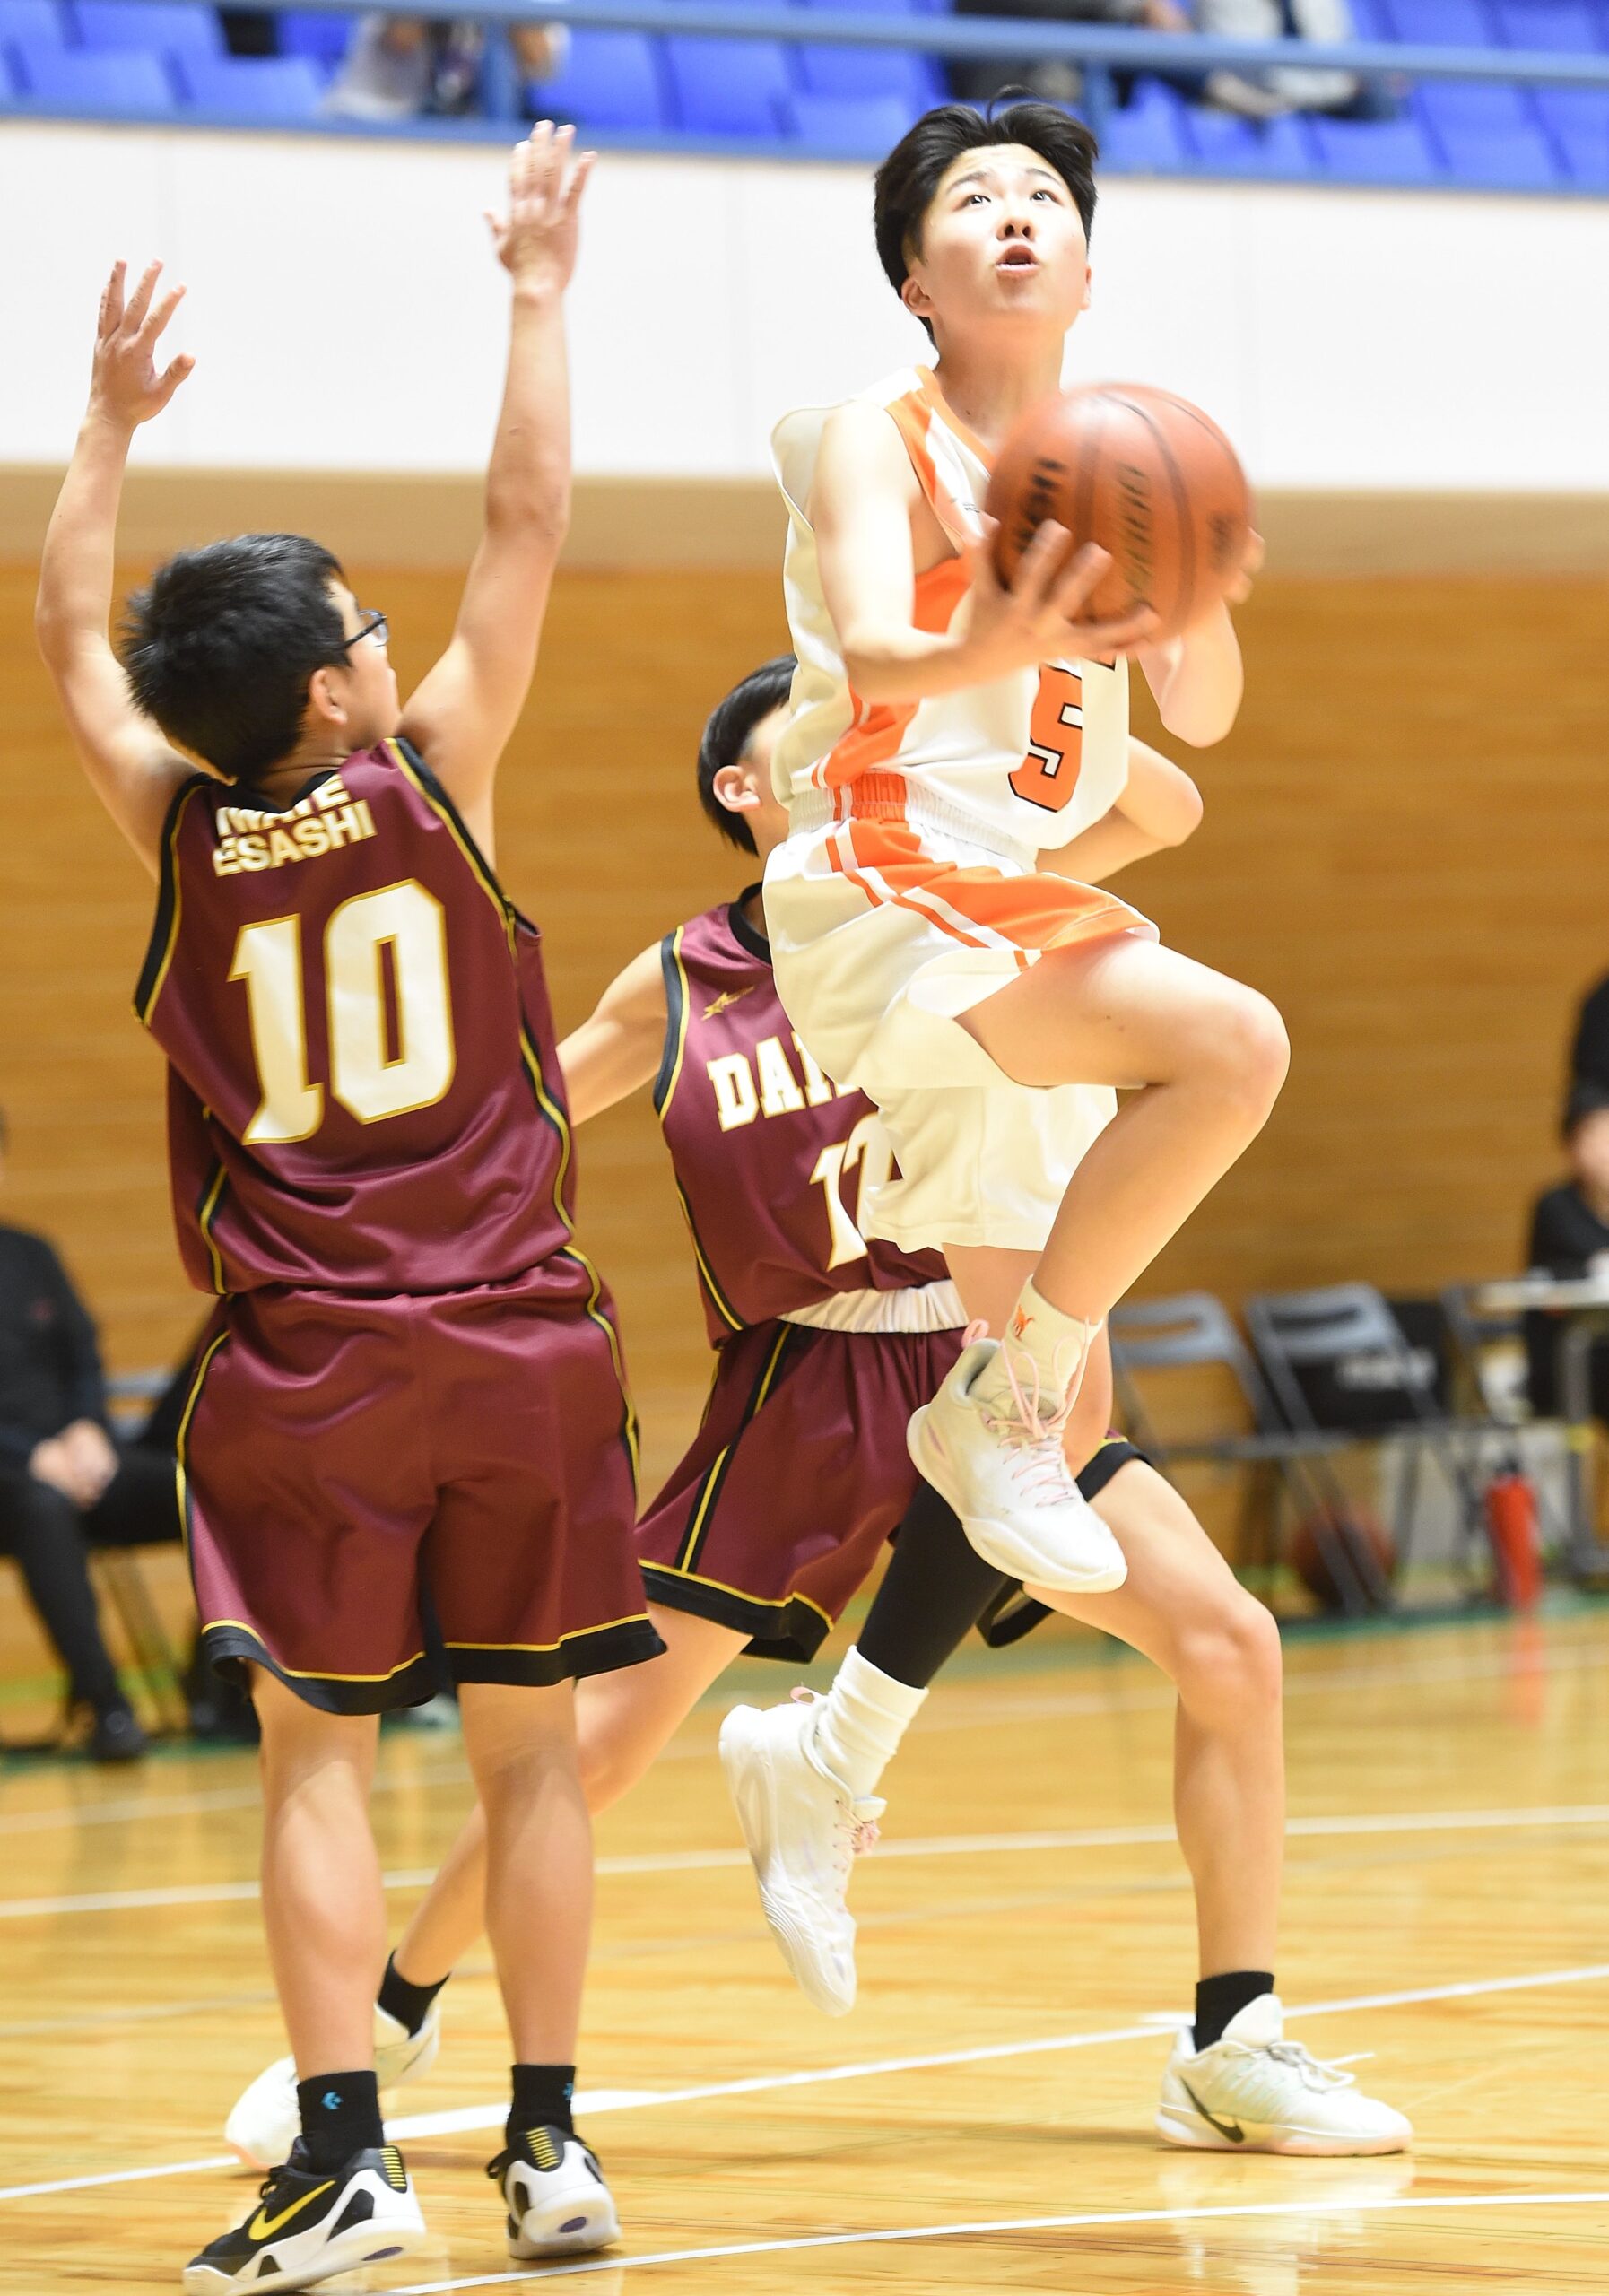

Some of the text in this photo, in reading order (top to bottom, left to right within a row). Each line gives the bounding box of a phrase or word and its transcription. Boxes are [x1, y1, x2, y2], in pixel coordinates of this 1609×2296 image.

[1008, 665, 1083, 813] 5
[213, 800, 378, 876] ESASHI
[227, 878, 456, 1145] 10
[707, 1031, 860, 1132] DAI
